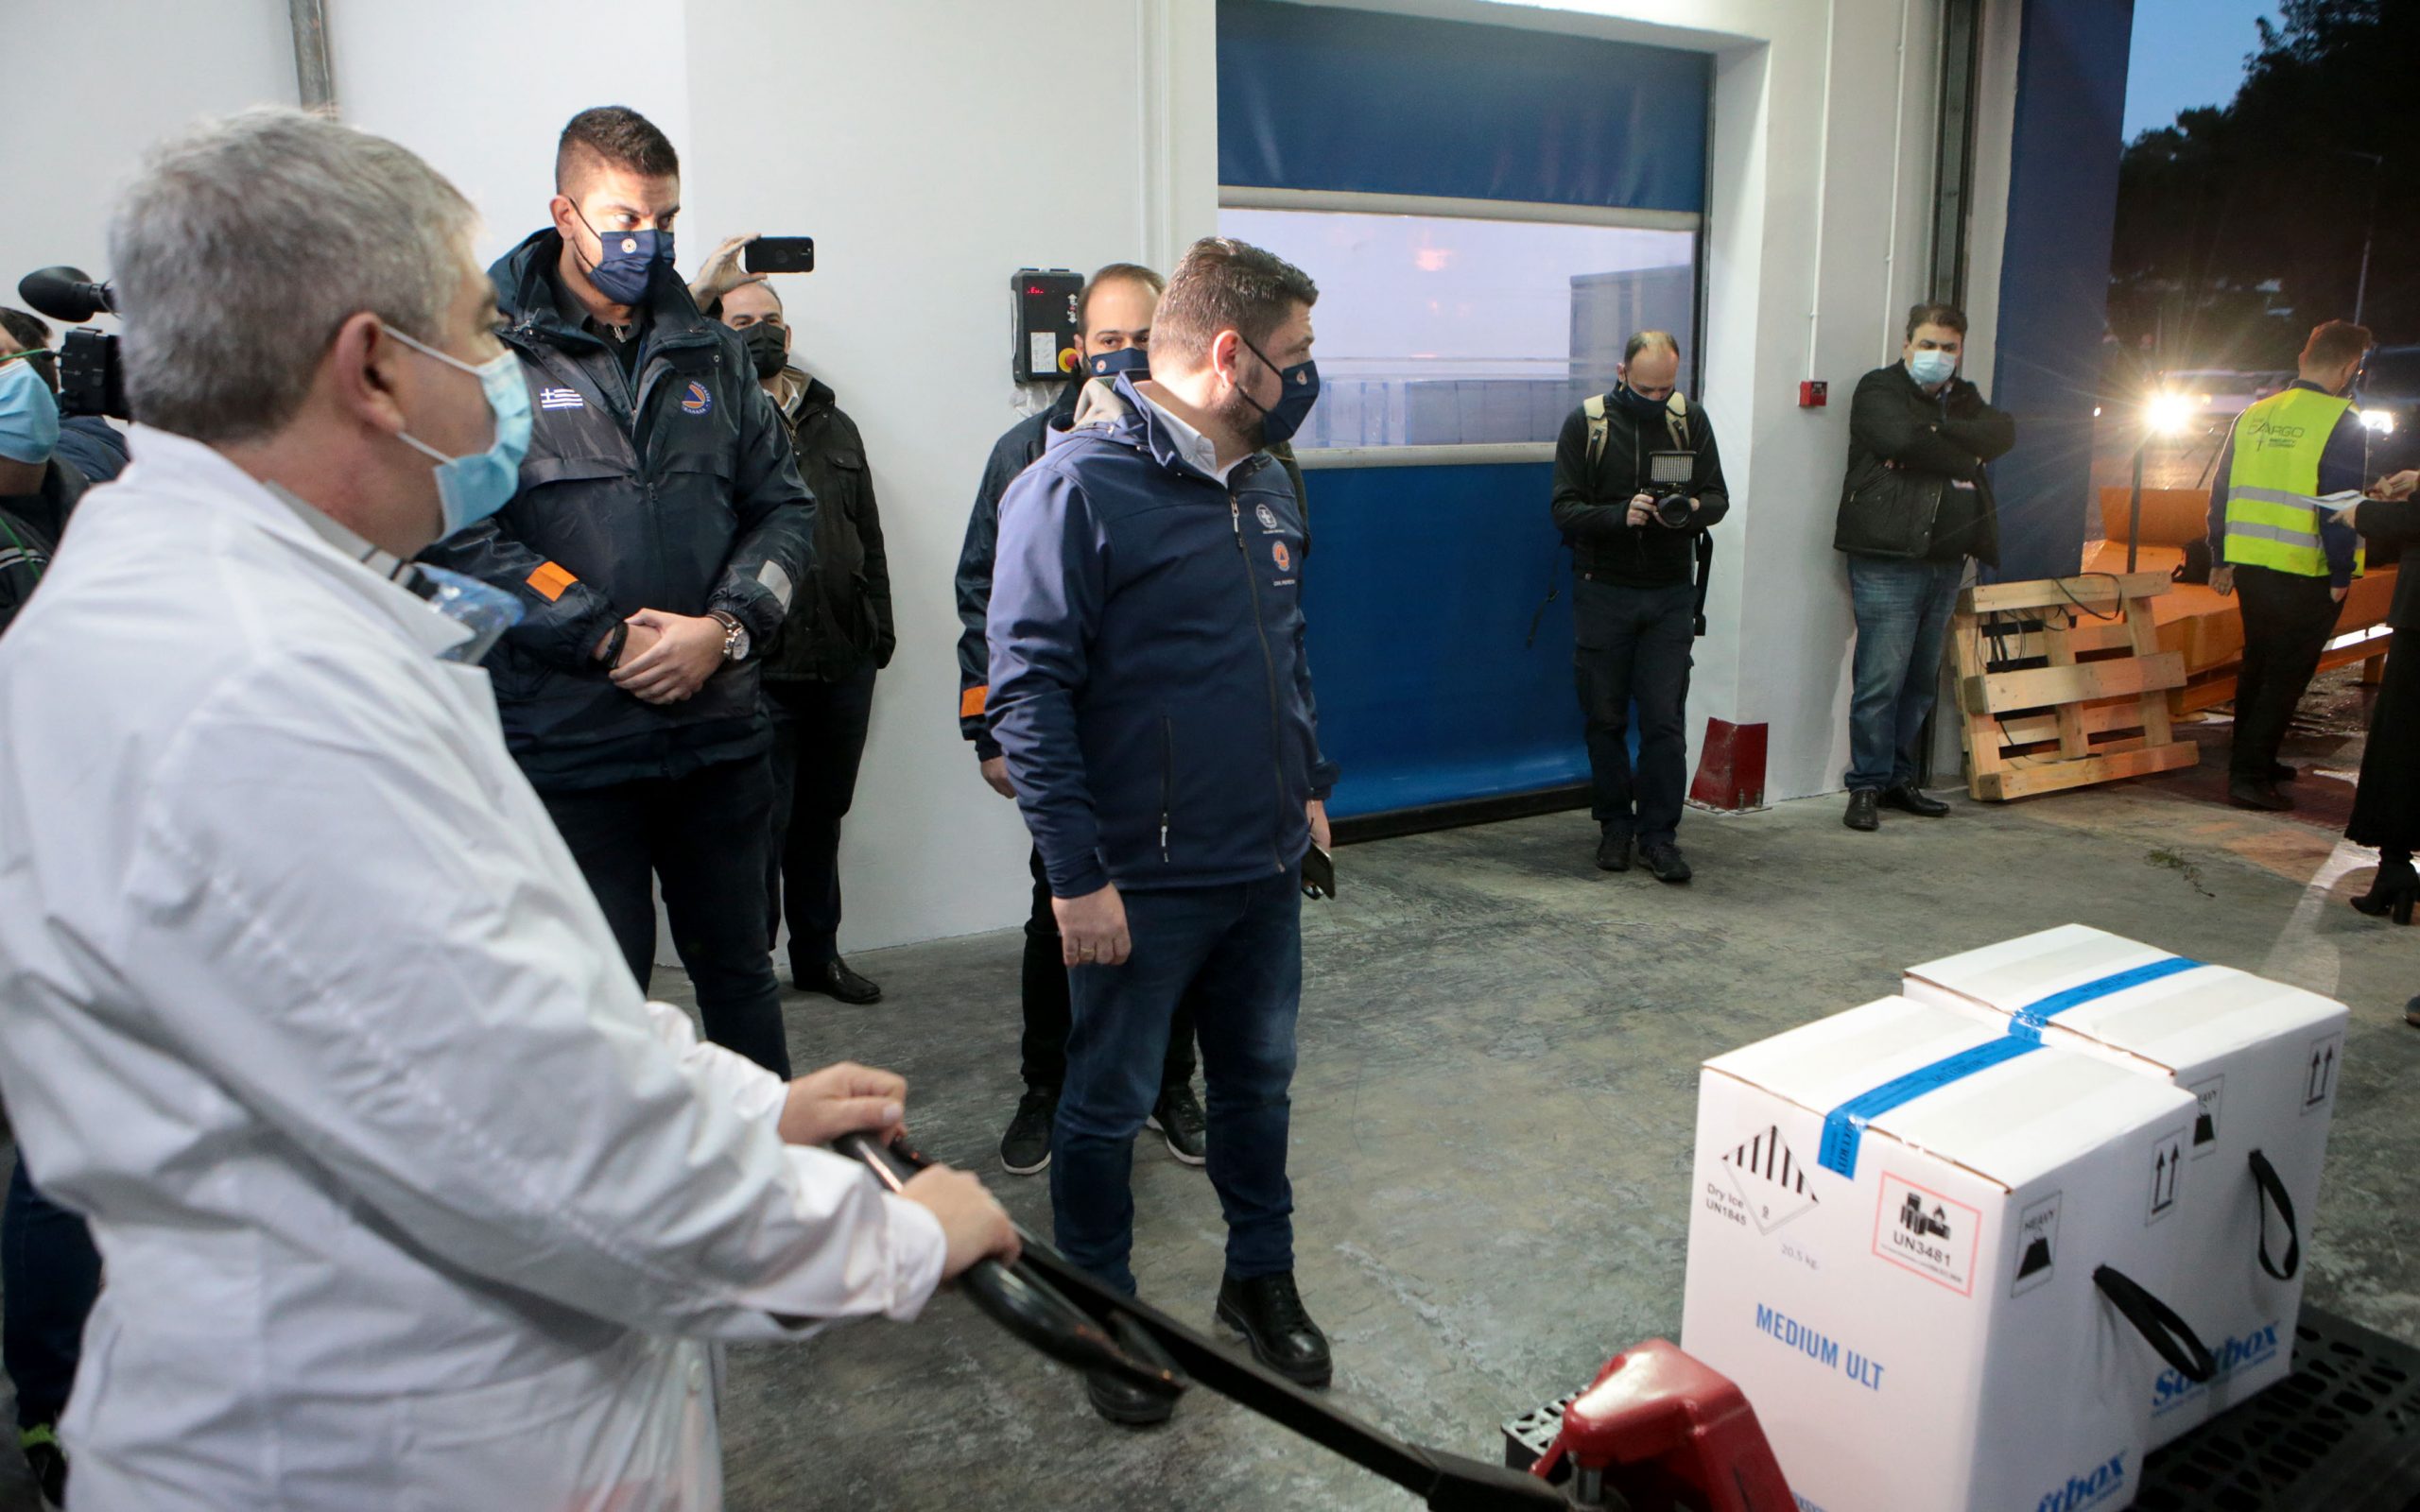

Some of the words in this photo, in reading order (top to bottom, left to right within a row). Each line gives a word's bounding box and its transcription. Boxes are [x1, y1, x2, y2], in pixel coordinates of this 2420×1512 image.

[1707, 1183, 1725, 1200] Dry
[1705, 1197, 1747, 1226] UN1845
[1893, 1230, 1951, 1267] UN3481
[1756, 1302, 1839, 1370] MEDIUM
[1845, 1349, 1885, 1391] ULT
